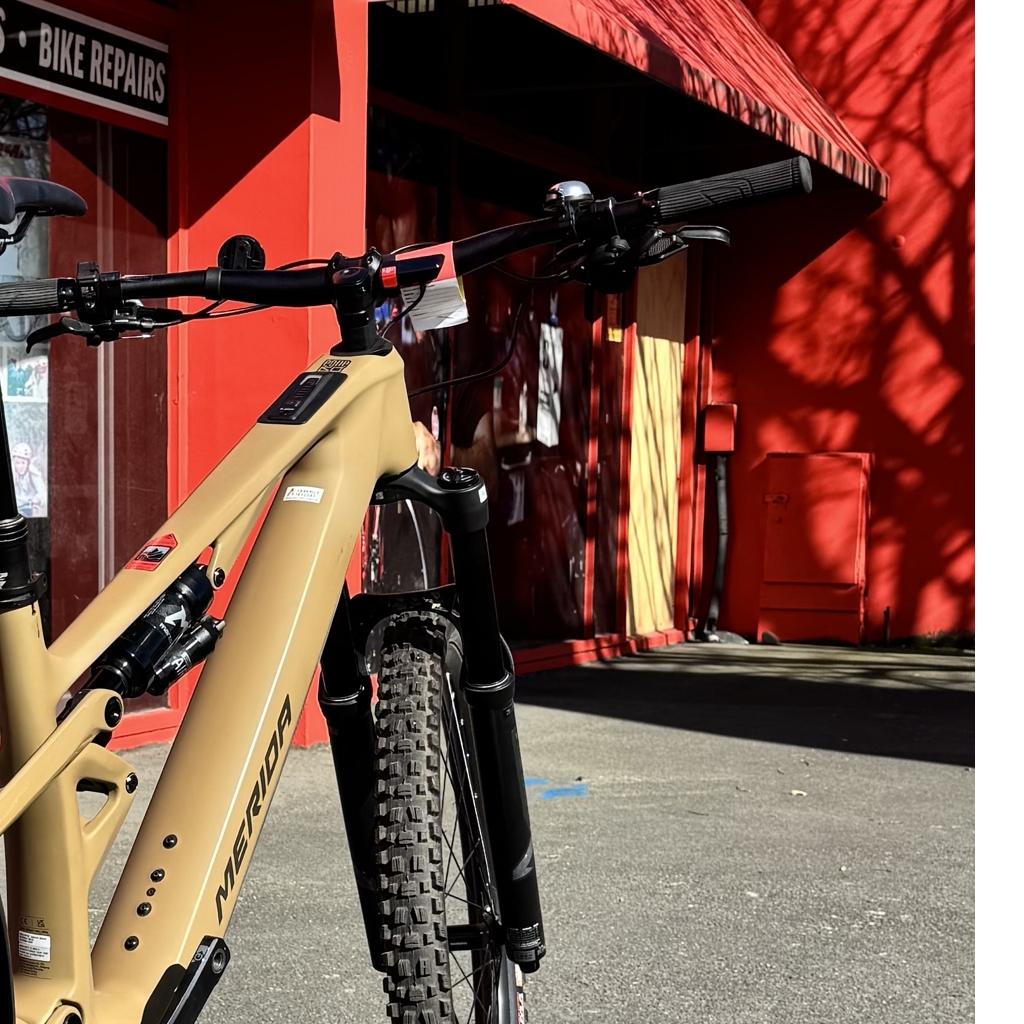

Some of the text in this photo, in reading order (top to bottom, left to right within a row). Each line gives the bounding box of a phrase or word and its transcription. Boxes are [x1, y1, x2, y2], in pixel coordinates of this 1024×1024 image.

[39, 22, 86, 79] BIKE
[89, 39, 166, 104] REPAIRS
[215, 693, 291, 926] MERIDA
